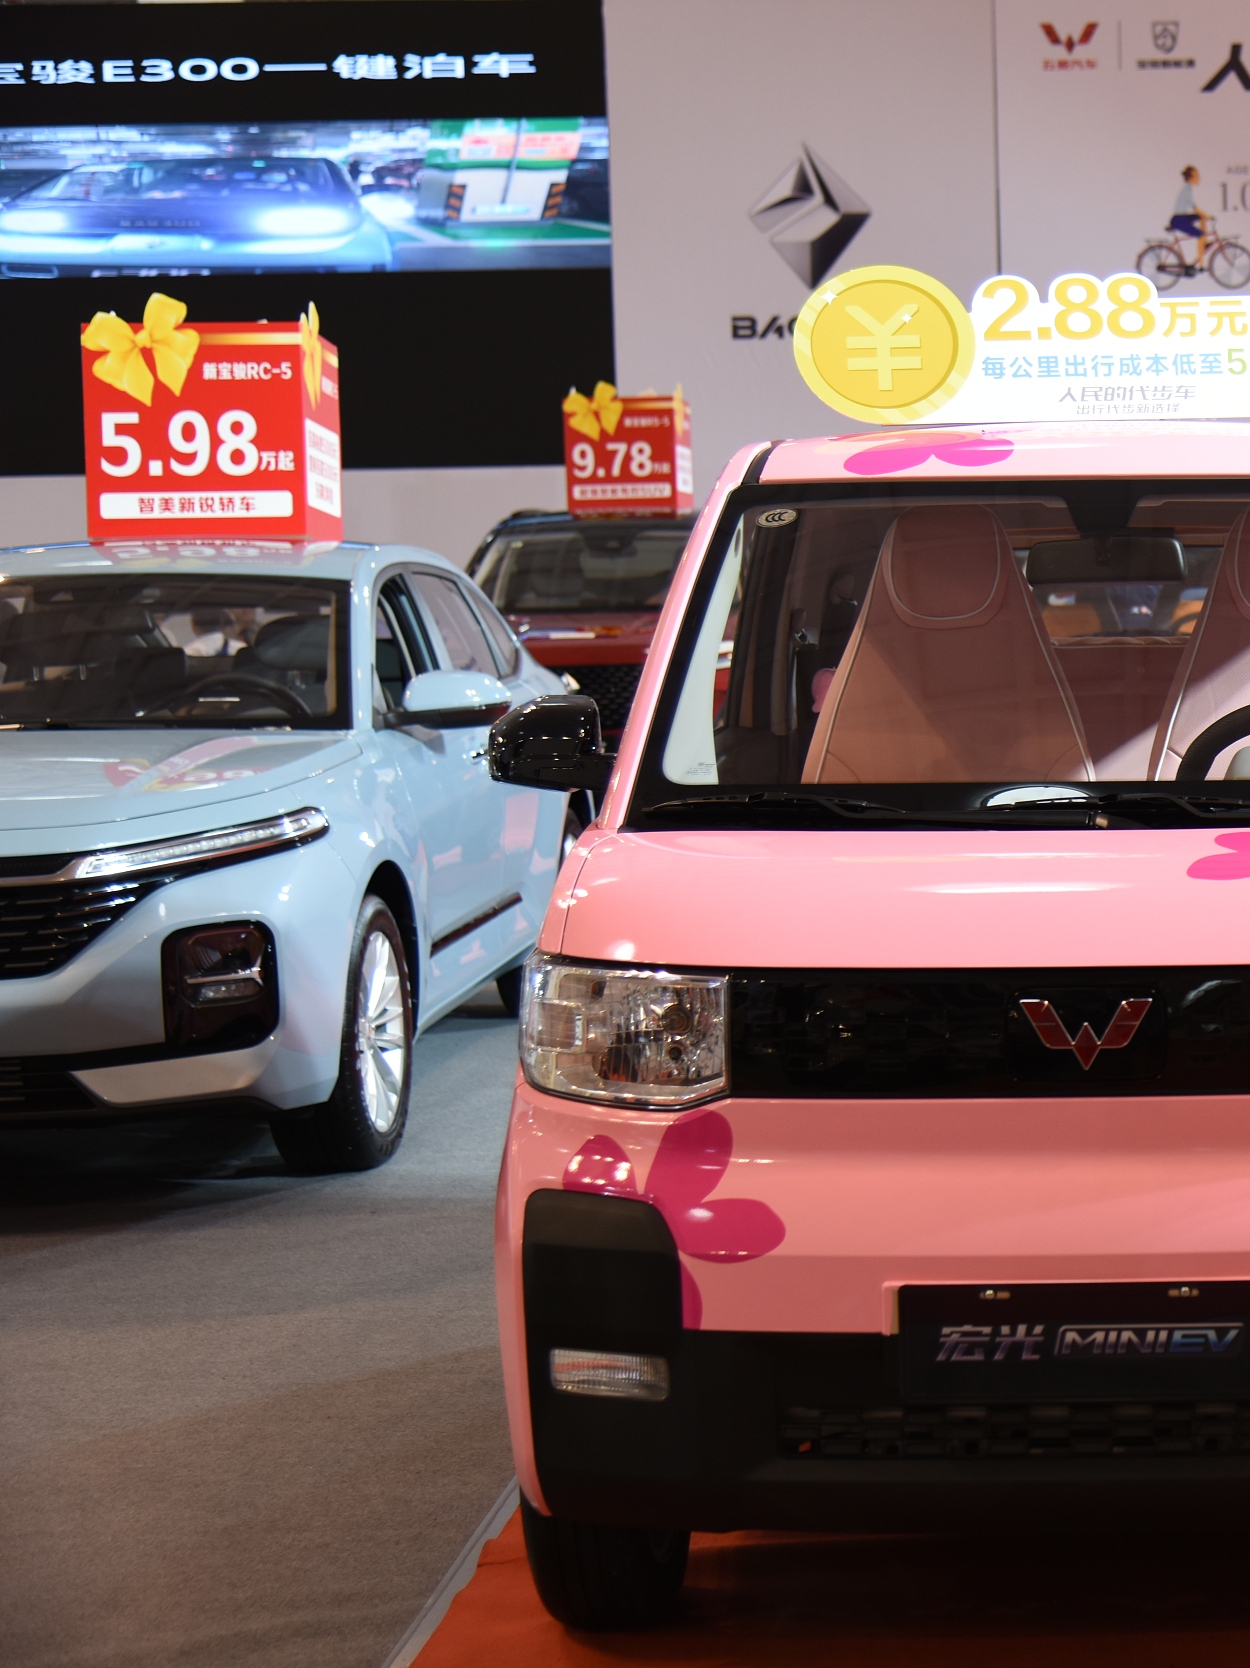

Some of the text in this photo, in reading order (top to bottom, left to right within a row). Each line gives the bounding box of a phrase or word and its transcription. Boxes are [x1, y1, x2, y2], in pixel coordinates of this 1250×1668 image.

[202, 361, 293, 381] 新宝骏RC-5
[1058, 384, 1198, 403] 人民的代步车
[1075, 402, 1180, 415] 出行代步新选择
[138, 496, 257, 515] 智美新锐轿车
[935, 1324, 1046, 1363] 宏光
